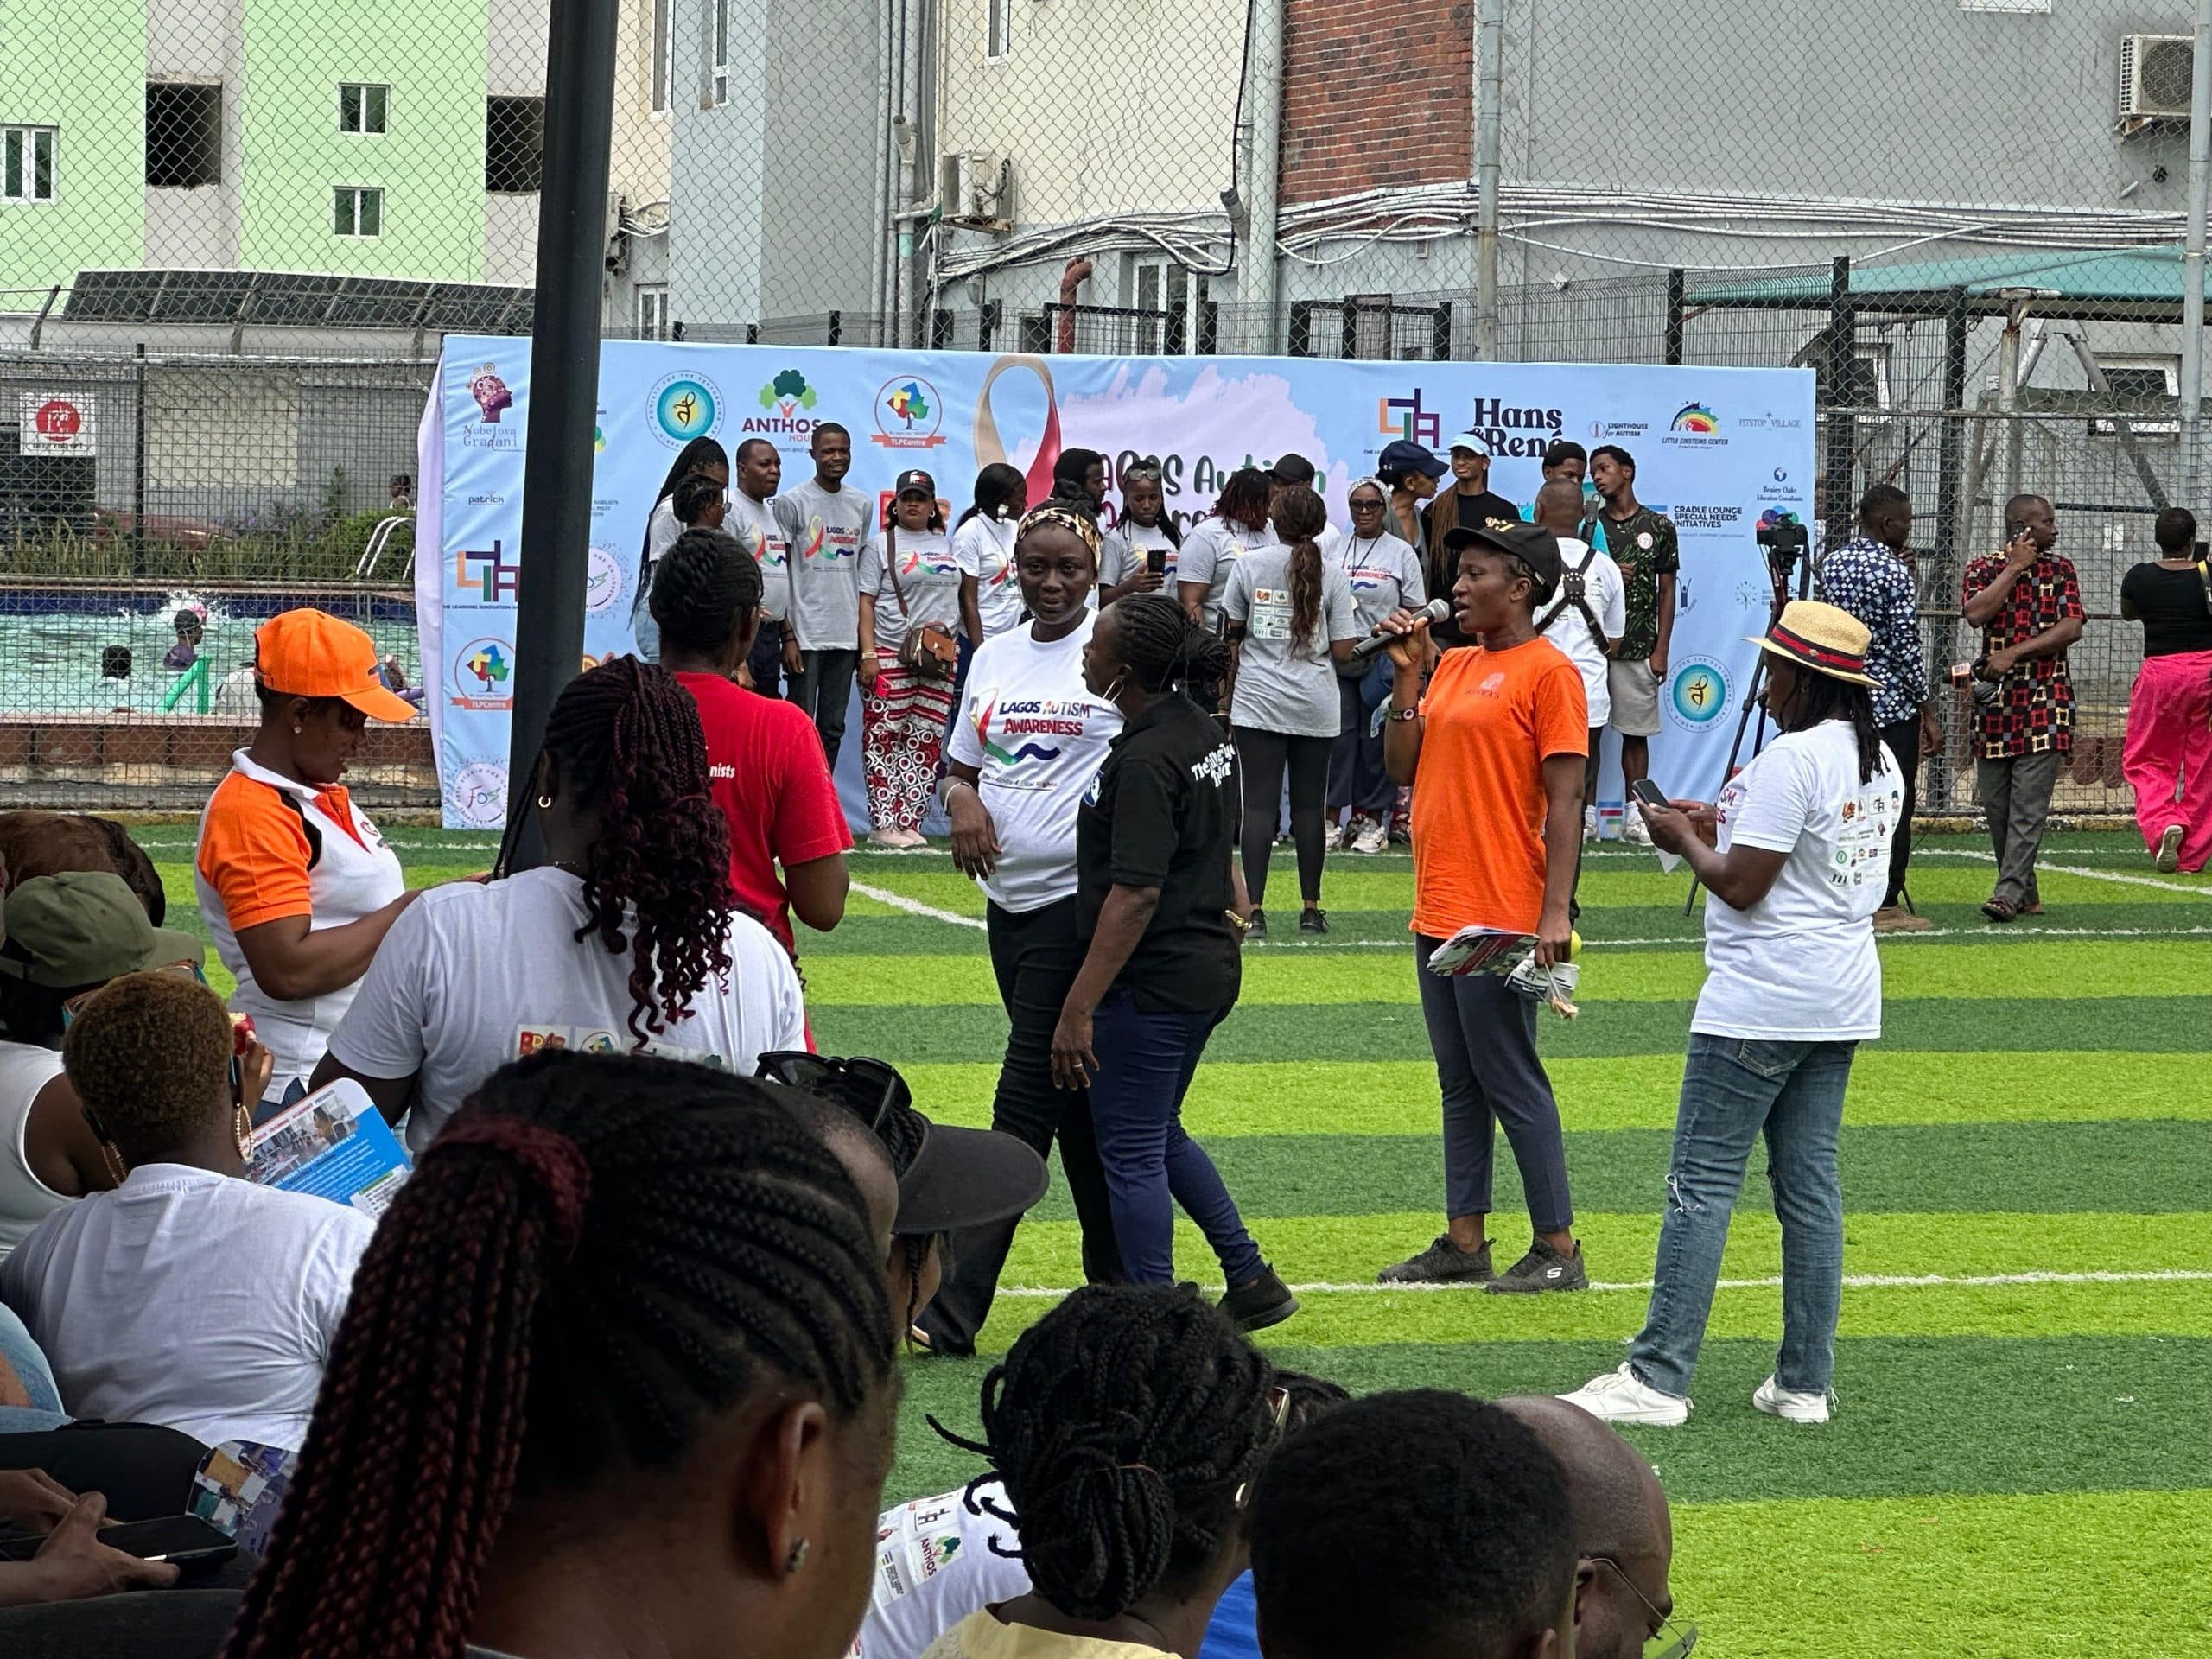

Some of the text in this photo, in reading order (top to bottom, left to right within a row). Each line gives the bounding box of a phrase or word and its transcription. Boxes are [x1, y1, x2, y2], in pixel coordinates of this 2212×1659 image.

[1474, 397, 1563, 429] Hans
[1771, 419, 1802, 428] VILLAGE
[999, 701, 1090, 719] LAGOS AUTISM
[1003, 718, 1083, 736] AWARENESS
[920, 1538, 937, 1577] ANTHOS
